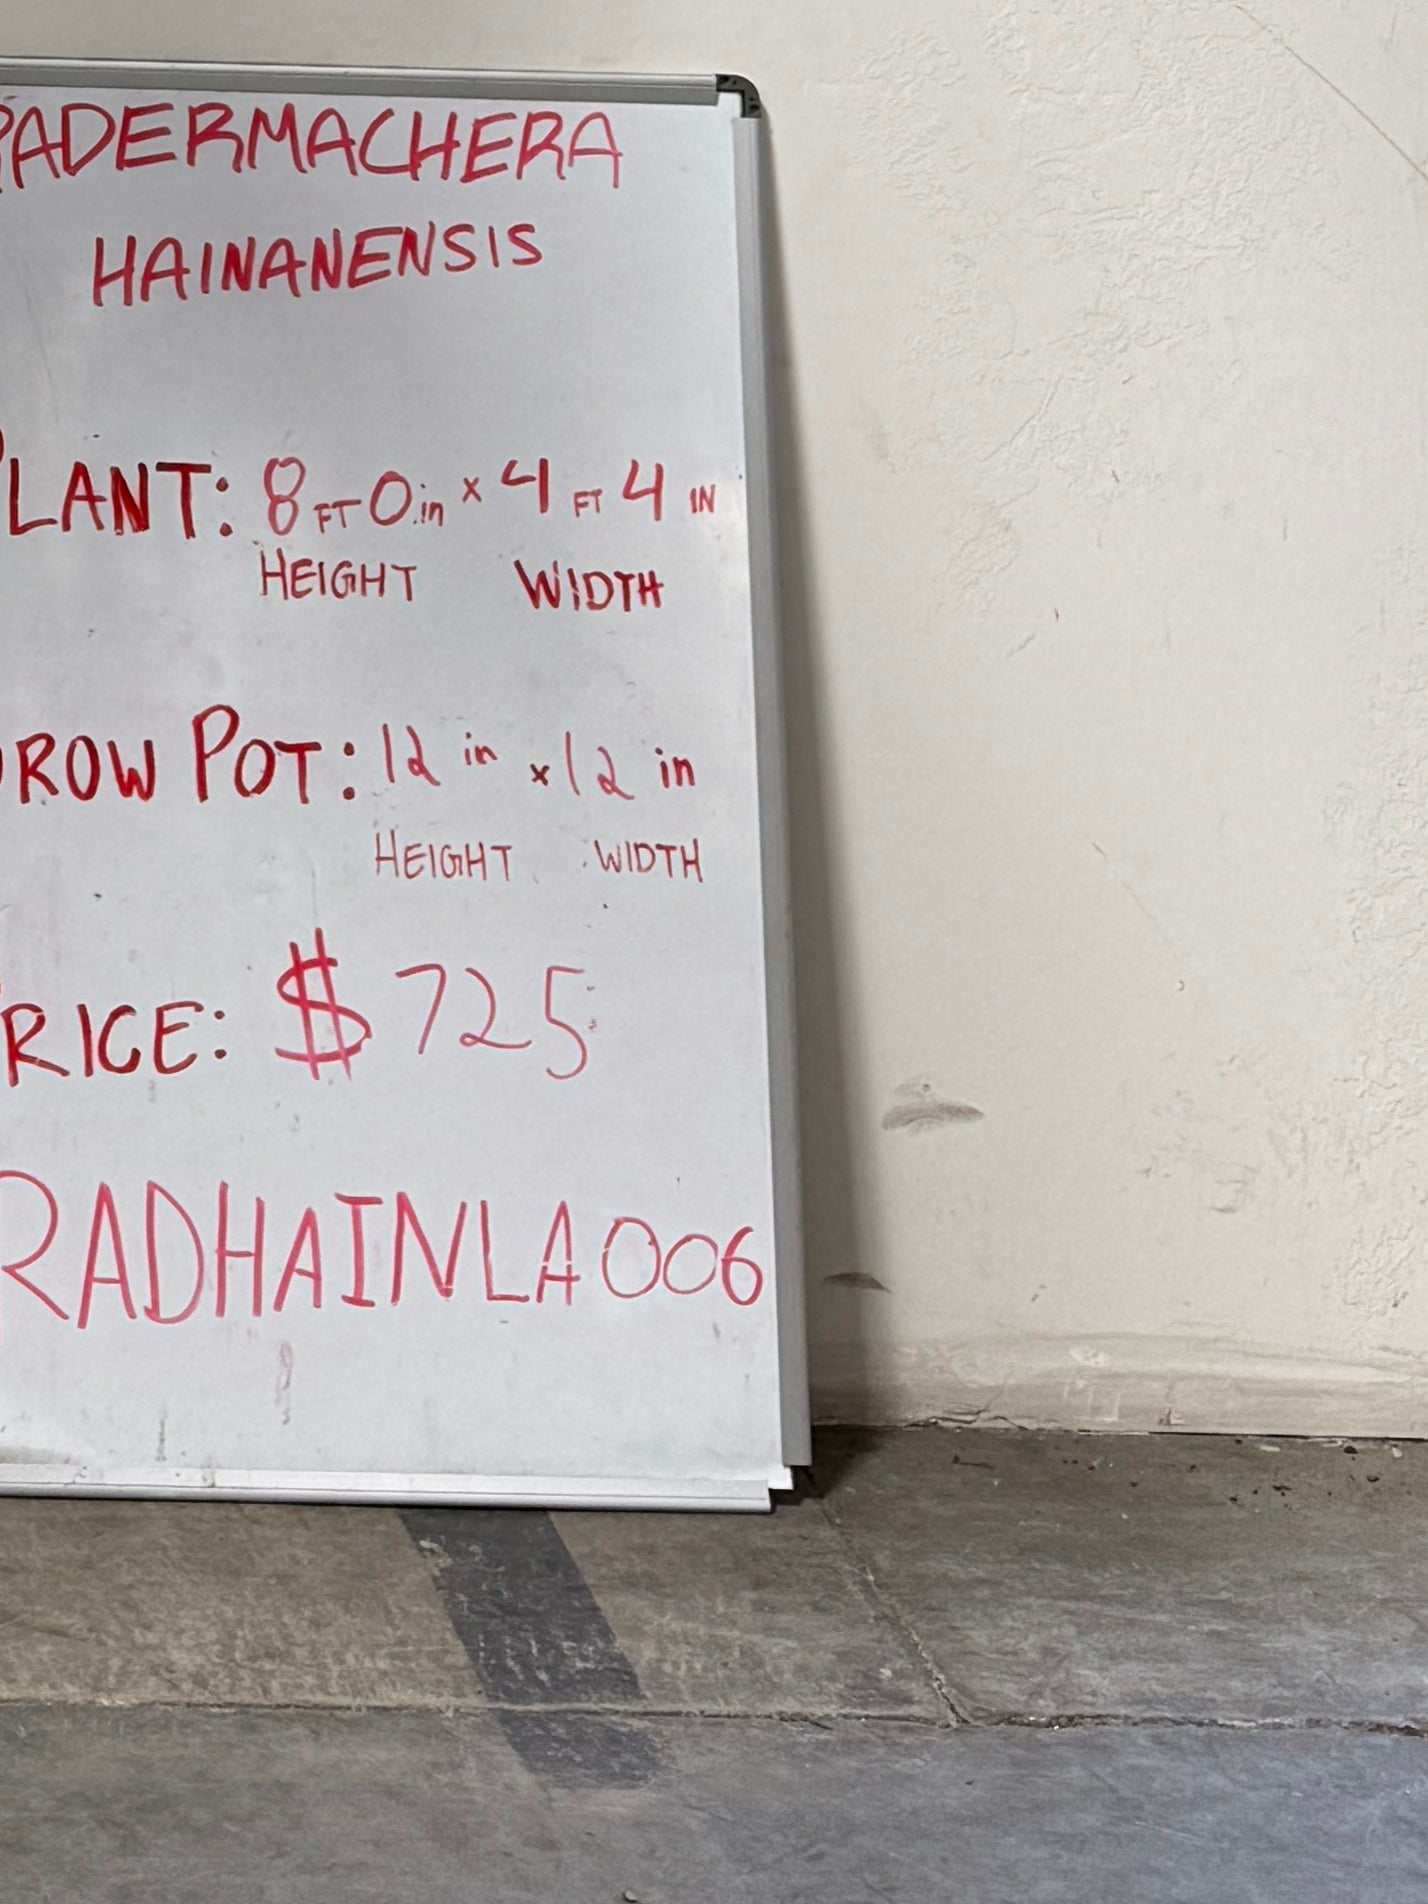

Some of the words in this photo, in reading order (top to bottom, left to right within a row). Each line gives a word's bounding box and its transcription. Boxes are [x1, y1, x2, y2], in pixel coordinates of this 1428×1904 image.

[92, 221, 544, 306] HAINANENSIS
[259, 547, 418, 603] HEIGHT
[513, 559, 665, 613] WIDTH
[374, 828, 513, 882] HEIGHT
[593, 837, 704, 883] WIDTH
